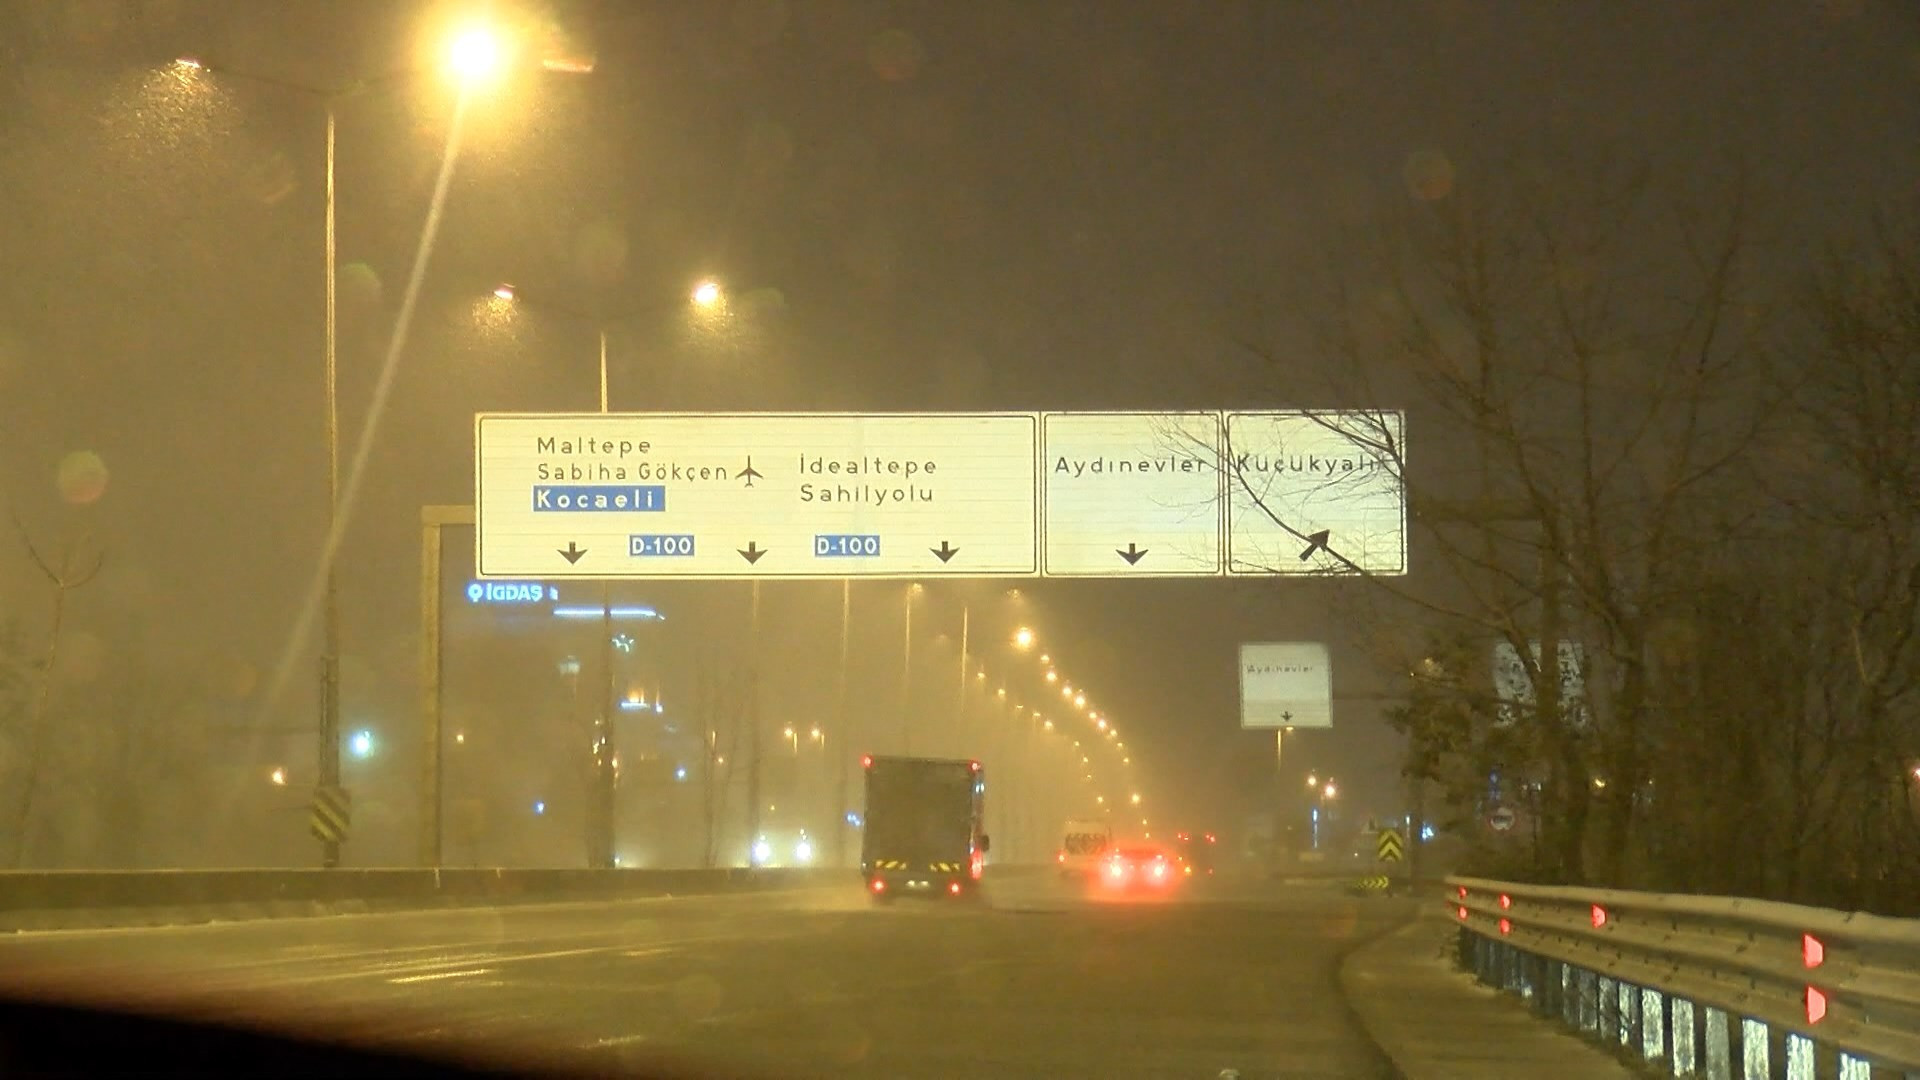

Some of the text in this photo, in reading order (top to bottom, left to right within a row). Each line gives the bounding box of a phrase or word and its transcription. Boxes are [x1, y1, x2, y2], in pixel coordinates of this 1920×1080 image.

[538, 436, 651, 459] Maltepe
[538, 462, 728, 483] Sabiha Gökçen
[800, 453, 937, 478] İdealtepe
[1055, 455, 1207, 478] Aydınevler
[537, 489, 655, 509] Kocaeli
[800, 484, 934, 505] Sahilyolu
[632, 537, 692, 555] D-100
[817, 537, 877, 555] D-100
[486, 583, 543, 602] İGDAŞ
